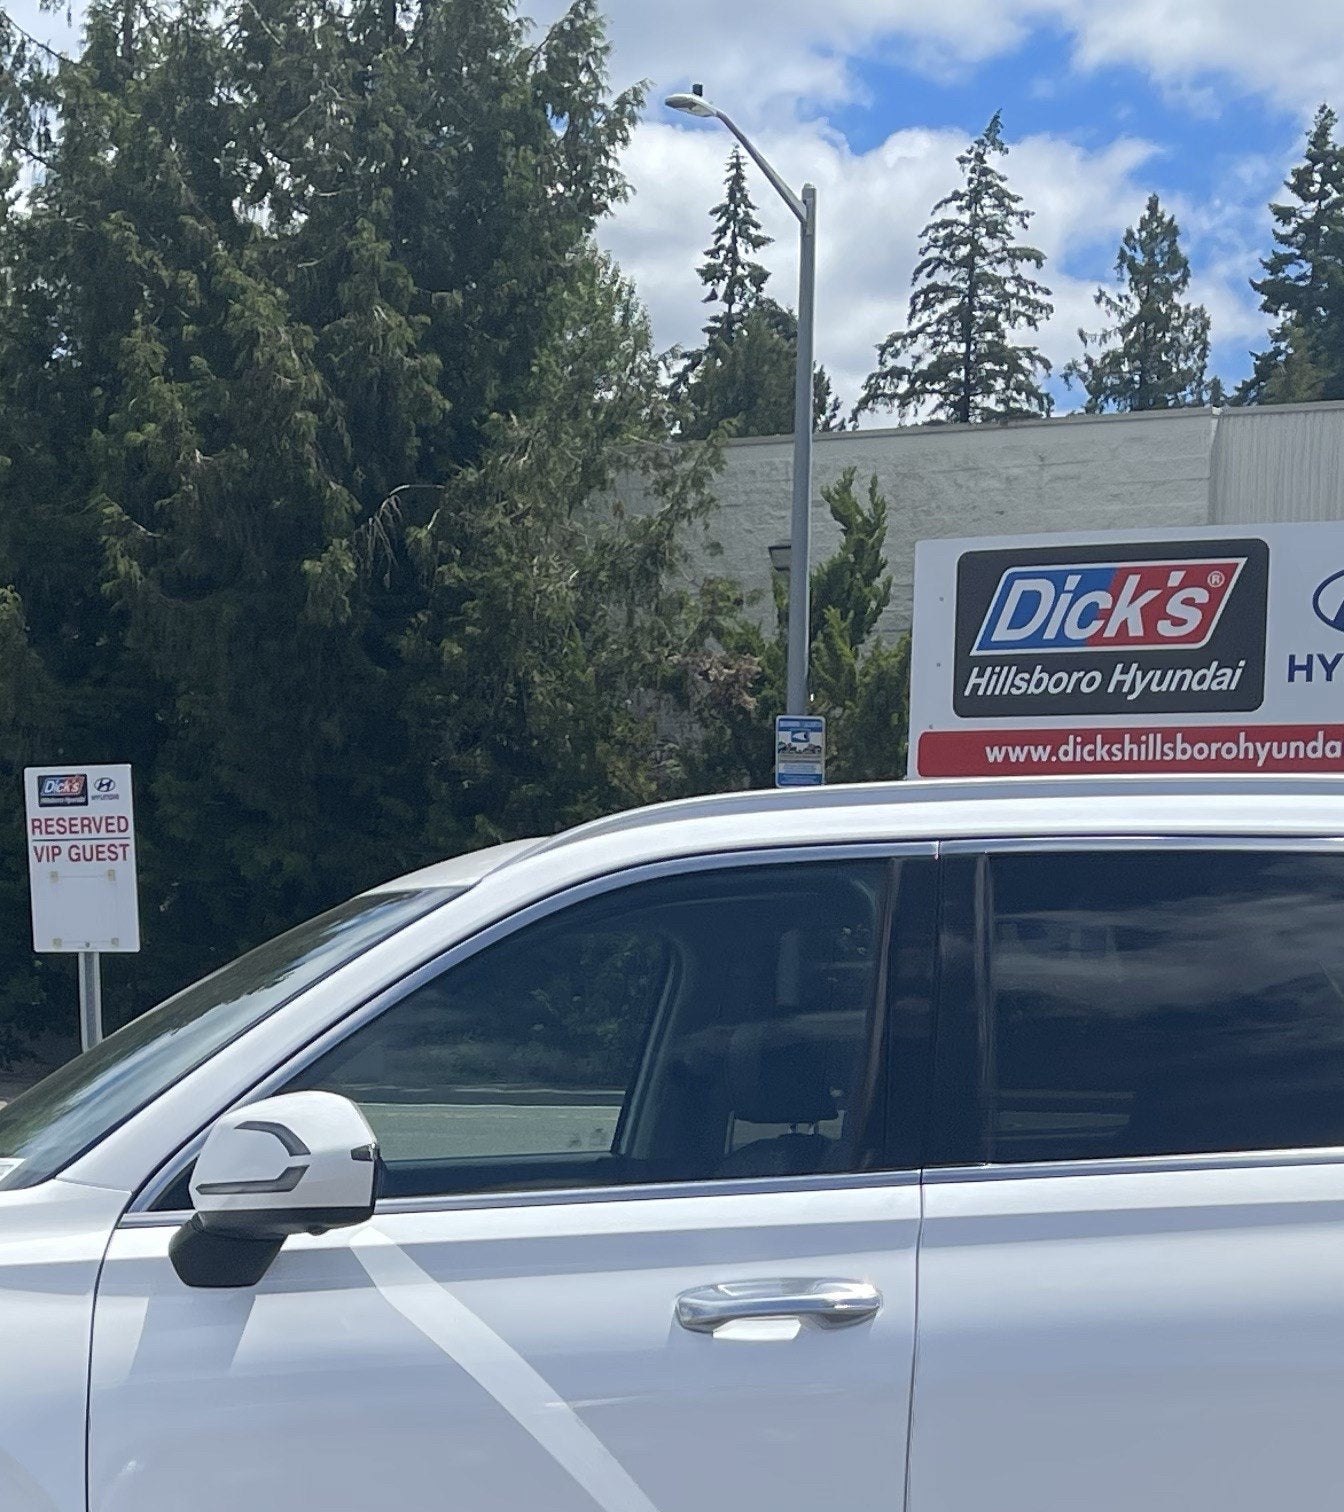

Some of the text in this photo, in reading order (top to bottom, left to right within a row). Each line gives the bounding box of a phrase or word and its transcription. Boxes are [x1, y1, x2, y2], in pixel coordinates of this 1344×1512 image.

[990, 570, 1210, 641] Dick's
[963, 659, 1246, 700] Hillsboro Hyundai
[31, 815, 129, 835] RESERVED
[33, 843, 130, 862] VIP GUEST
